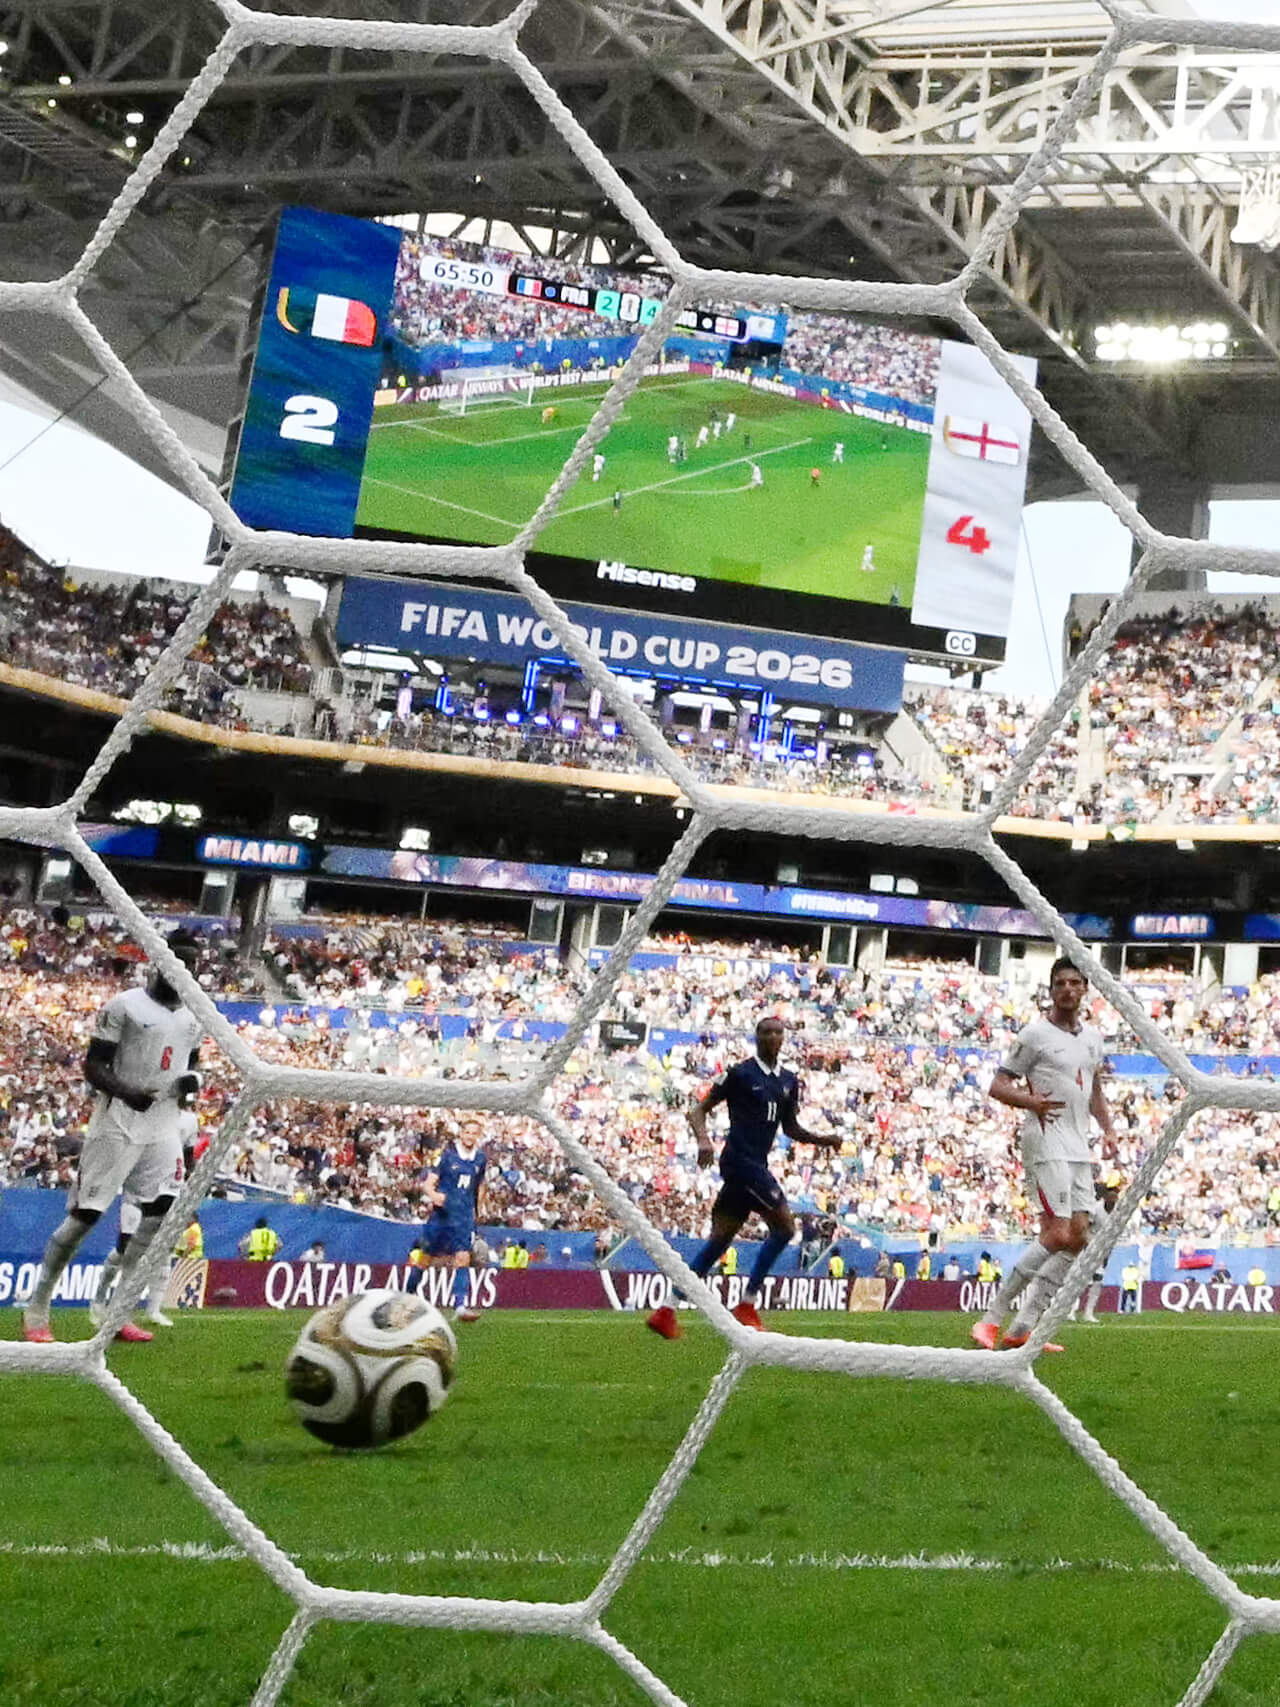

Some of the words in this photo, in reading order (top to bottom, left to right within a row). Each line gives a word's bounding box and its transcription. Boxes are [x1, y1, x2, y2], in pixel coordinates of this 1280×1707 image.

[432, 261, 495, 289] 65:50
[560, 285, 590, 307] FRA
[601, 296, 613, 312] 2
[279, 394, 339, 446] 2
[945, 515, 991, 555] 4
[596, 560, 697, 593] Hisense
[400, 601, 490, 643] FIFA
[643, 634, 721, 667] CUP
[724, 645, 854, 690] 2026
[949, 635, 973, 652] CC
[203, 836, 300, 866] MIAMI
[1134, 915, 1209, 934] MIAMI
[160, 1045, 174, 1072] 6
[766, 1100, 779, 1122] 11
[263, 1261, 373, 1311] QATAR
[778, 1277, 850, 1311] AIRLINE
[1159, 1281, 1275, 1314] QATAR
